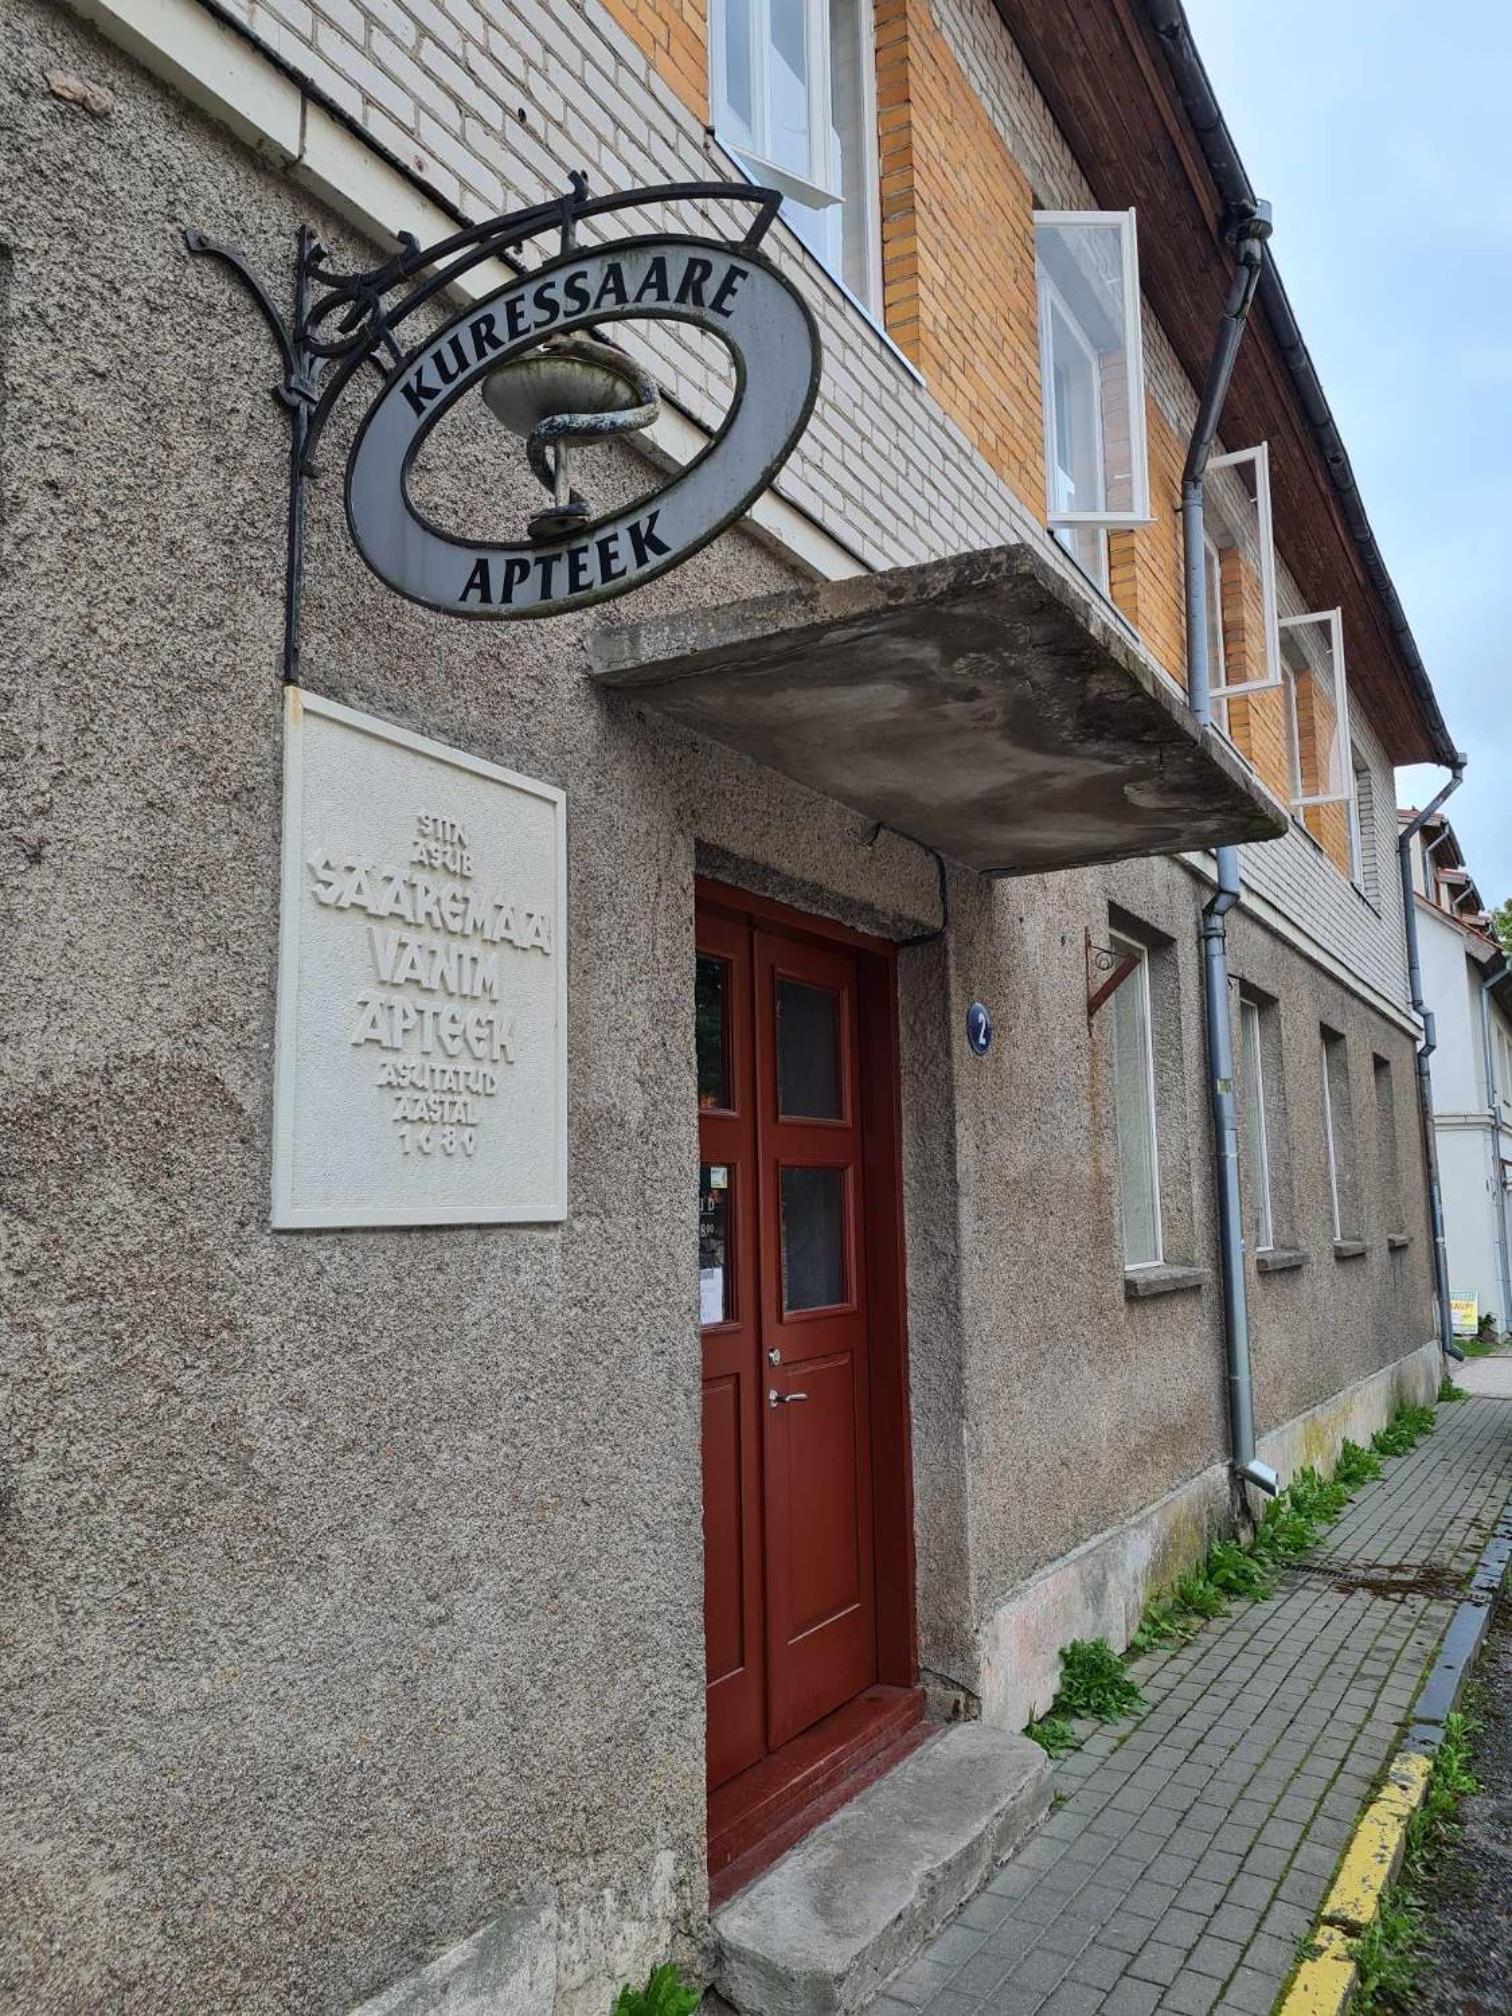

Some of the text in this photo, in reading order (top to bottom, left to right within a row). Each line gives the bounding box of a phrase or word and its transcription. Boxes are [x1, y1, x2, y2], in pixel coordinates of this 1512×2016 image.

[400, 255, 749, 418] KURESSAARE
[458, 509, 672, 604] APTEEK
[416, 814, 467, 849] SIIN
[410, 840, 474, 878] ASUB
[306, 848, 552, 956] SAAREMAA
[367, 926, 498, 1002] VANIM
[350, 991, 514, 1064] APTEEK
[978, 1012, 986, 1045] 2
[376, 1060, 498, 1097] ASUTATUD
[392, 1094, 480, 1127] AASTAL
[398, 1125, 476, 1157] 1680
